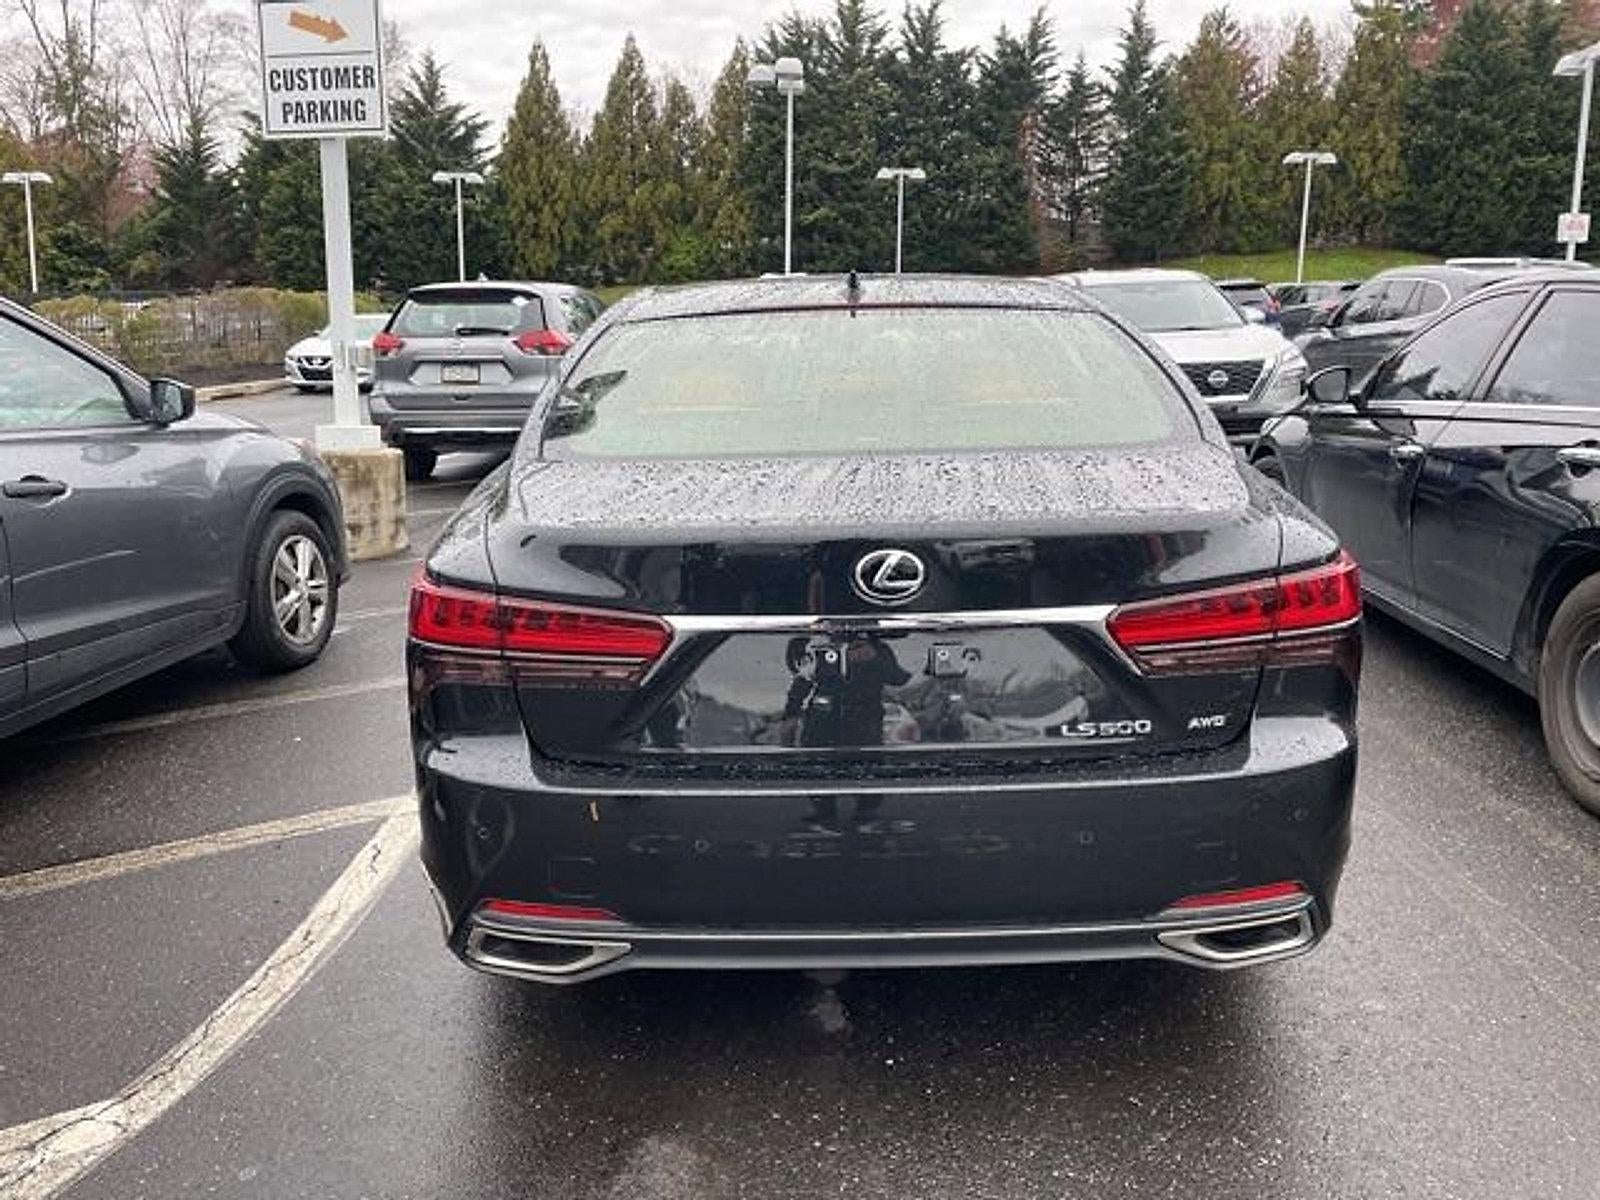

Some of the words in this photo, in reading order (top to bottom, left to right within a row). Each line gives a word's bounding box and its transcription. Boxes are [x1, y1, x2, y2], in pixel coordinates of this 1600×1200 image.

[269, 65, 376, 93] CUSTOMER
[281, 98, 367, 124] PARKING
[1187, 714, 1227, 730] AWD
